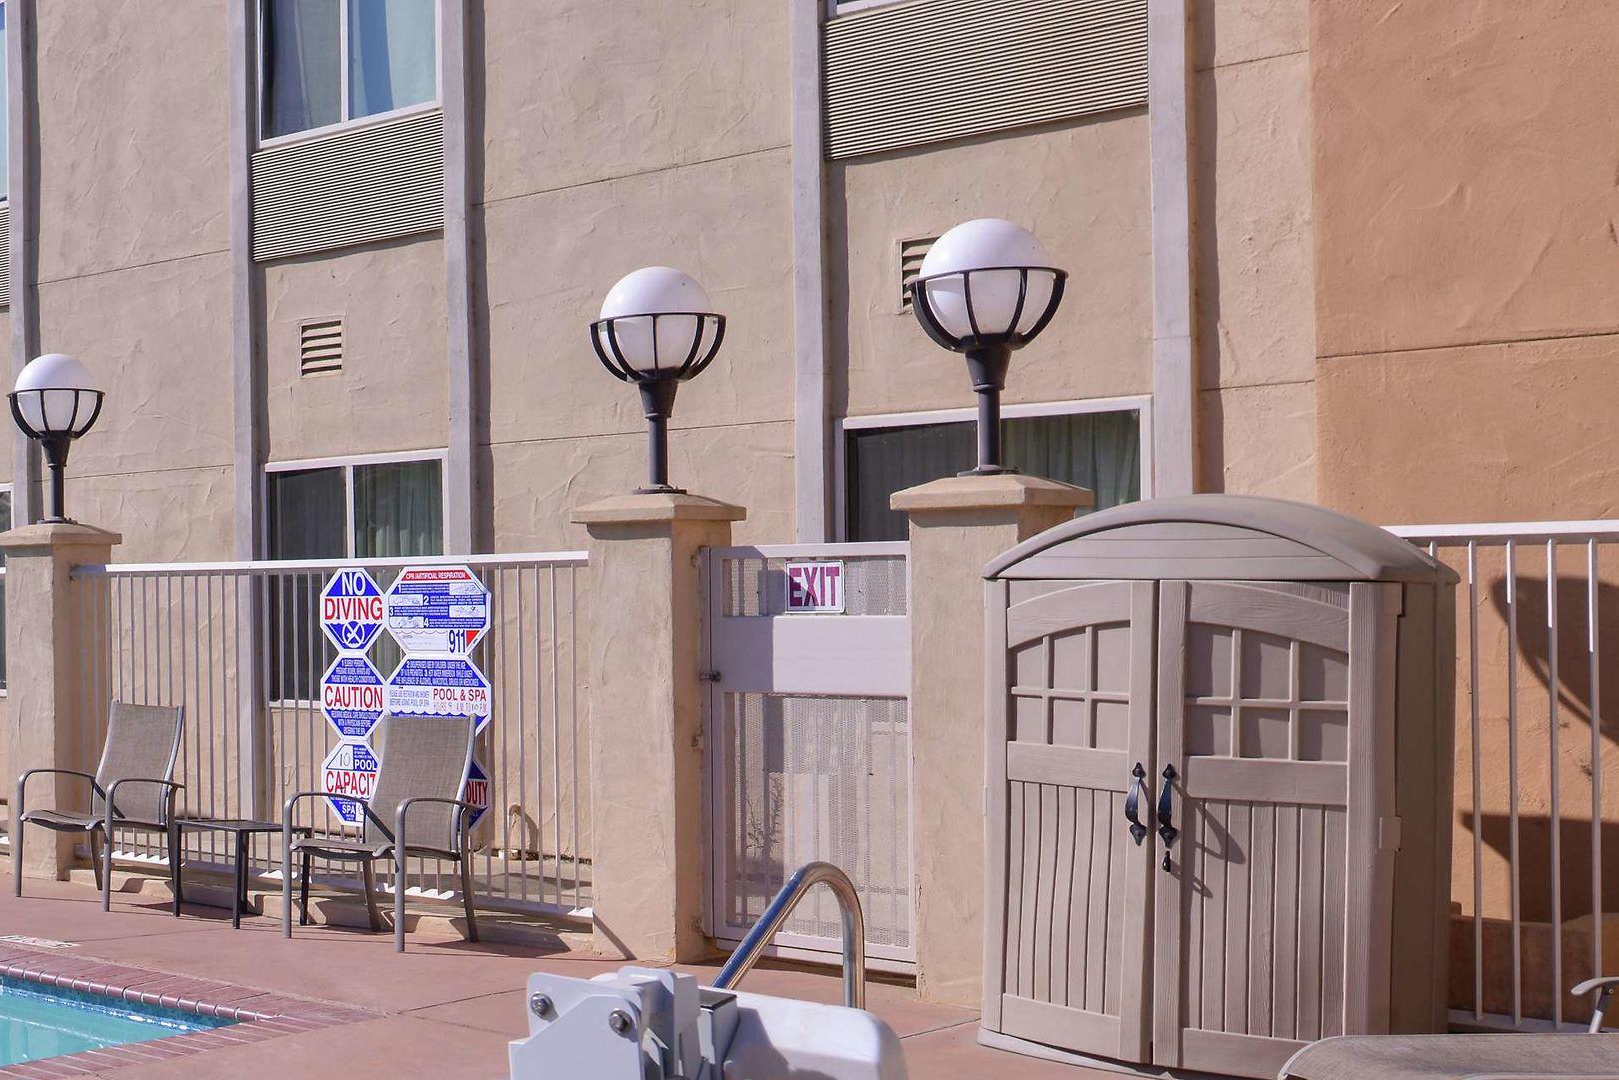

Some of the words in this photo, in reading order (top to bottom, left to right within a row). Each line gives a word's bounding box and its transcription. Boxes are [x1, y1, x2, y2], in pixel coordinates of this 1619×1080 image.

[341, 572, 366, 596] NO
[788, 566, 840, 607] EXIT
[324, 597, 383, 621] DIVING
[389, 606, 394, 616] 3
[423, 596, 429, 605] 2
[423, 618, 429, 627] 4
[448, 629, 466, 653] 911
[324, 685, 383, 708] CAUTION
[433, 688, 458, 701] POOL
[460, 689, 466, 701] &
[468, 690, 487, 702] SPA
[354, 759, 377, 770] POOL
[326, 771, 376, 796] CAPACIT
[466, 781, 488, 806] DUTY
[342, 805, 356, 815] SPA
